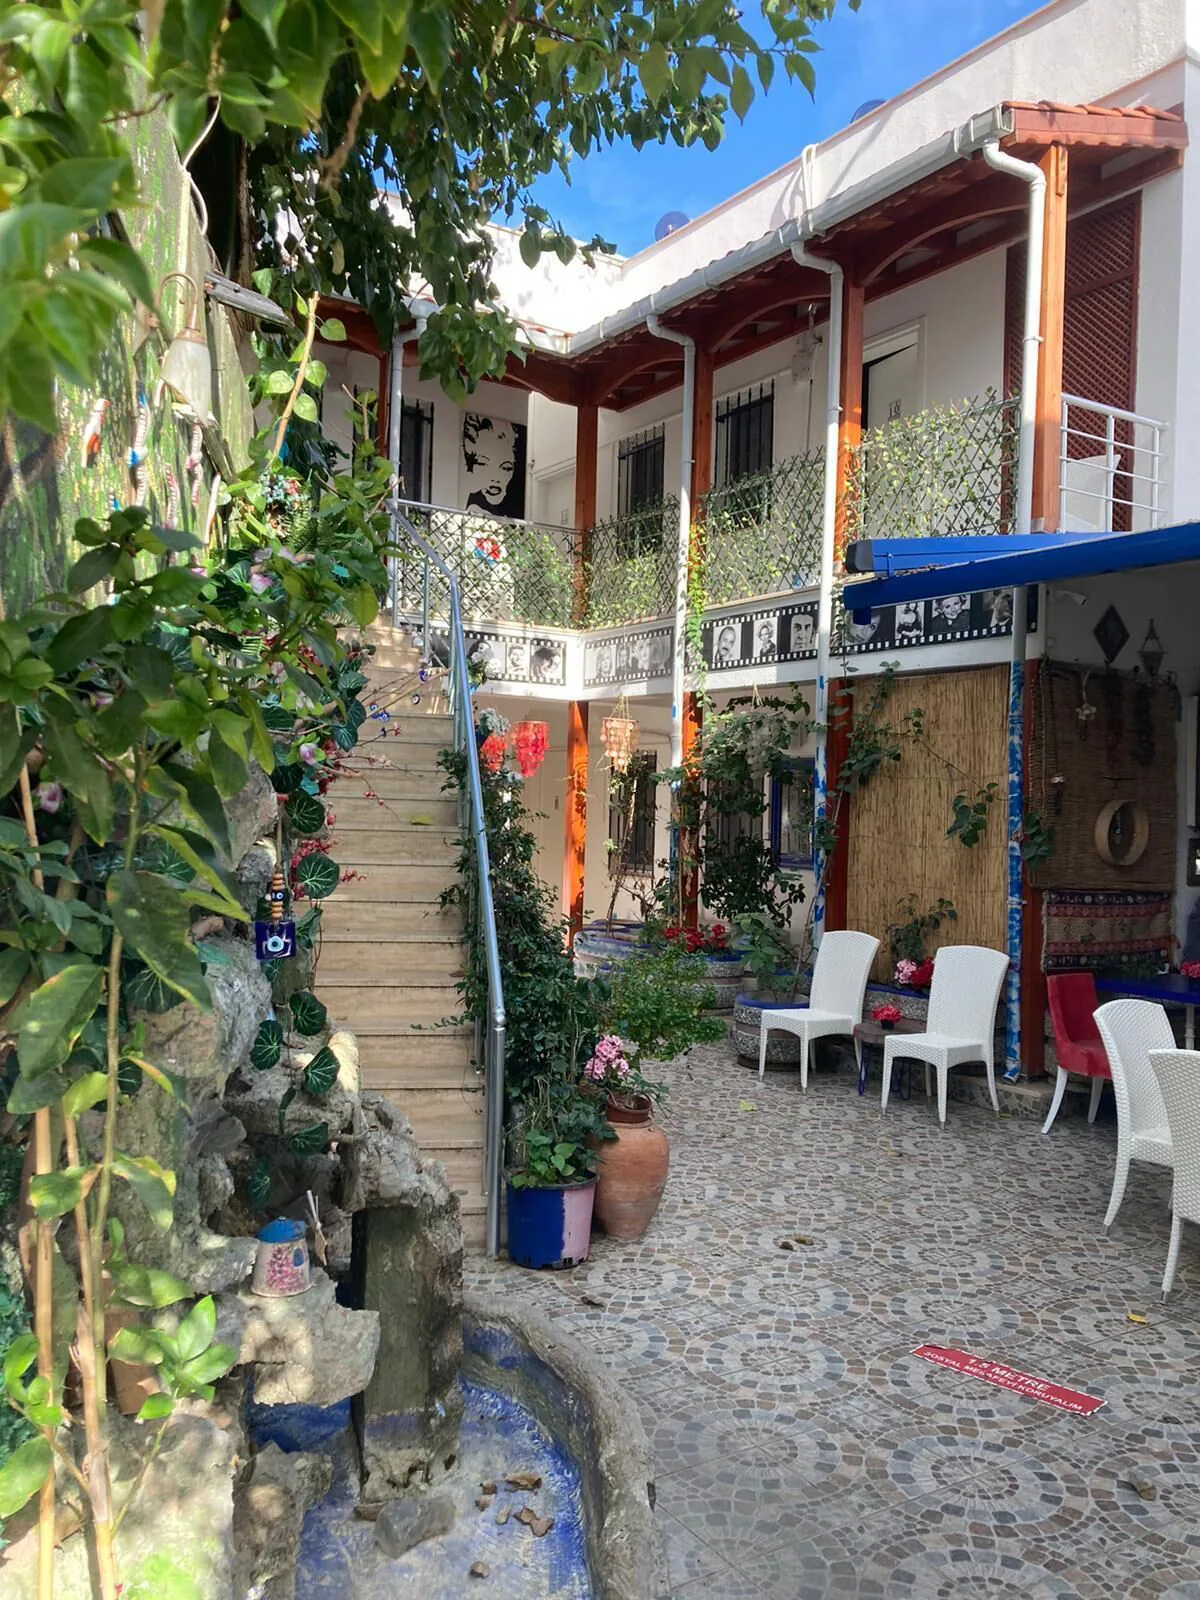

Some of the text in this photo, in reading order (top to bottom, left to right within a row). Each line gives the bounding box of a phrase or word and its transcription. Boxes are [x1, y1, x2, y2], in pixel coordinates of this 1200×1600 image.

[923, 1351, 962, 1367] SOSYAL
[1018, 1385, 1083, 1411] KORUYALIM
[991, 1367, 1052, 1391] METRE
